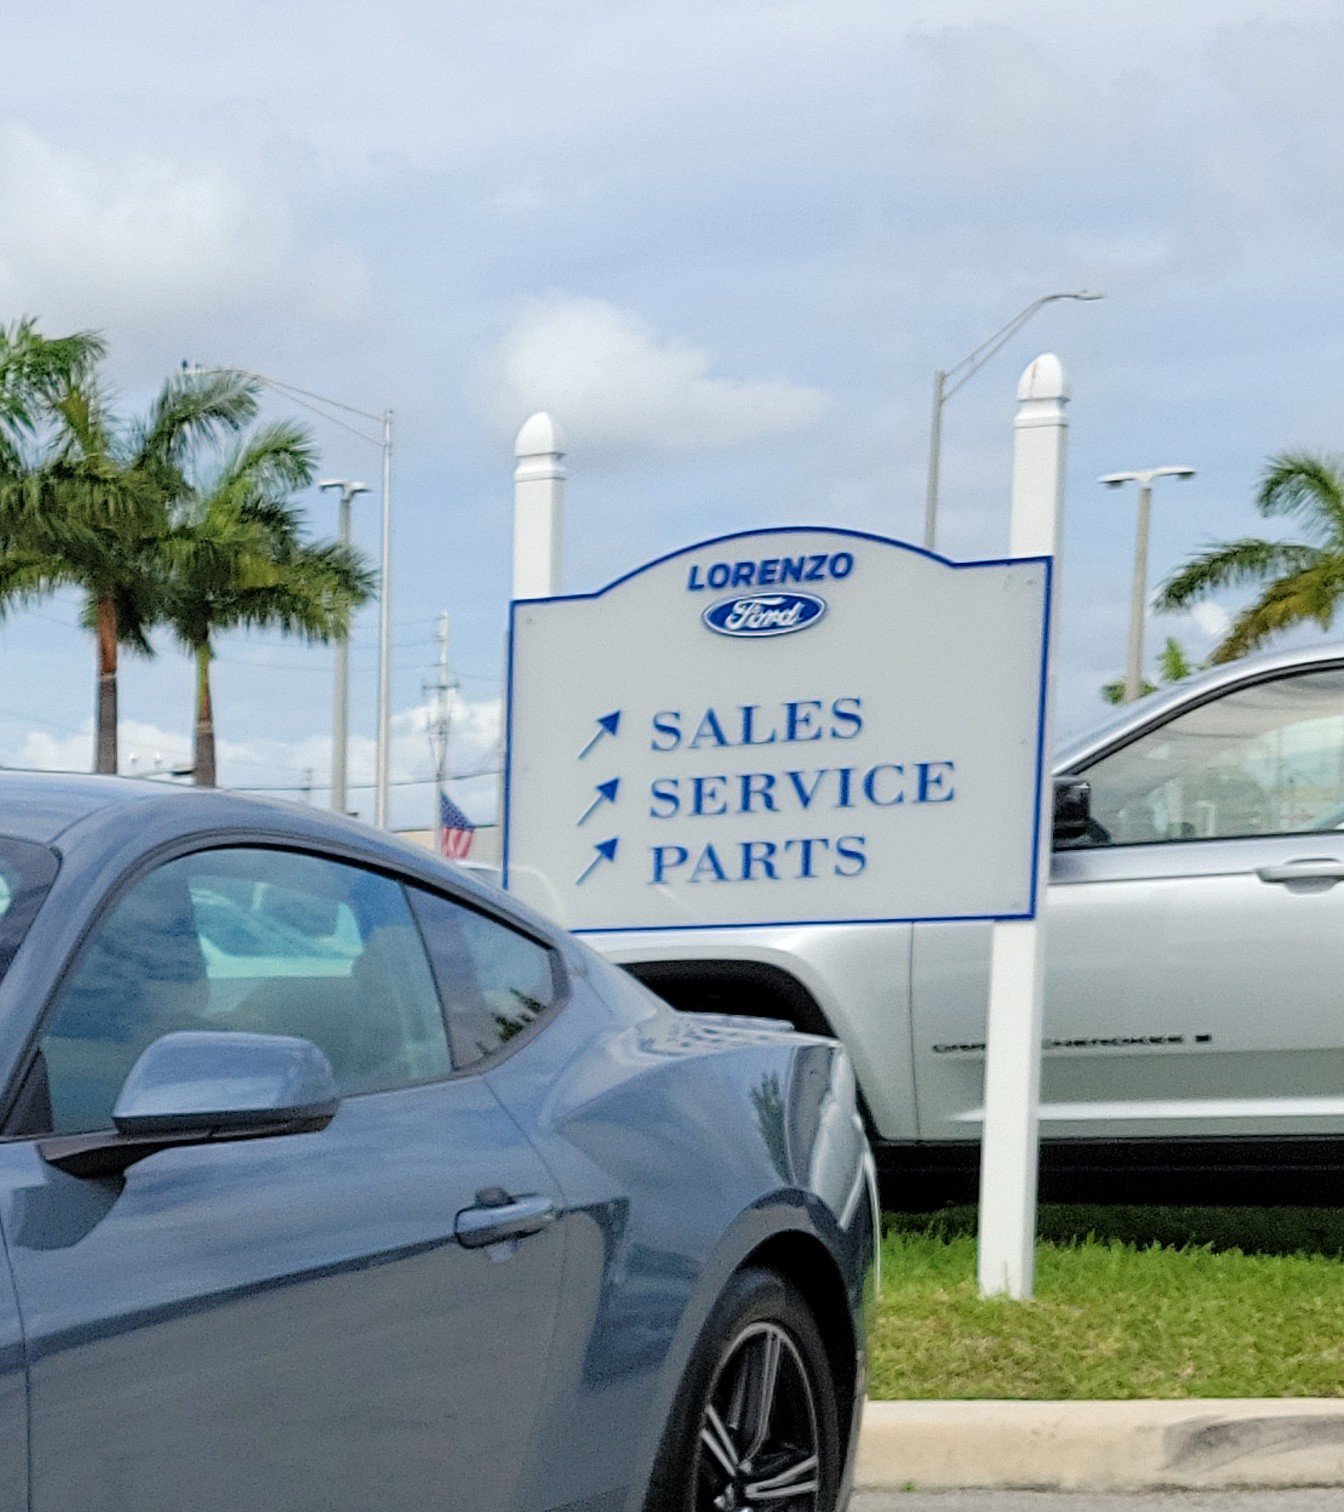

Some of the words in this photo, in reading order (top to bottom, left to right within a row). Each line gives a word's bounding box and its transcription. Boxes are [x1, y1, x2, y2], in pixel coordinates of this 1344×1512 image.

[687, 552, 854, 591] LORENZO
[724, 597, 804, 630] Ford
[651, 697, 863, 751] SALES
[649, 761, 955, 818] SERVICE
[647, 834, 867, 885] PARTS
